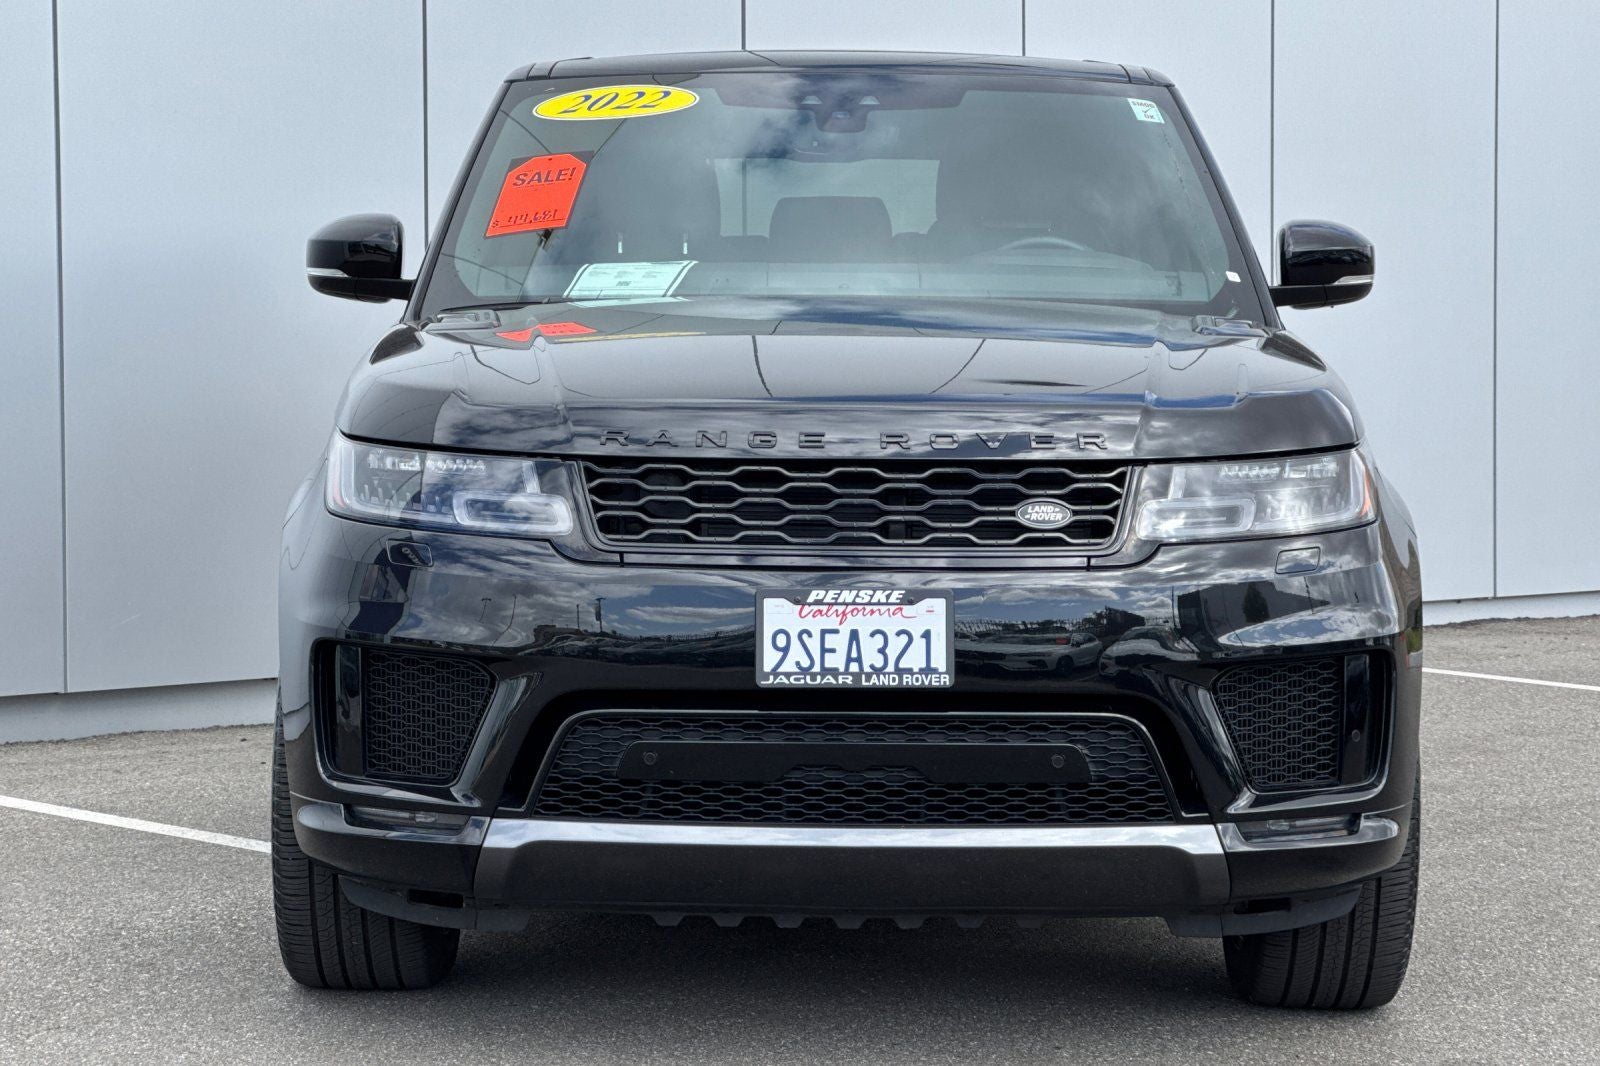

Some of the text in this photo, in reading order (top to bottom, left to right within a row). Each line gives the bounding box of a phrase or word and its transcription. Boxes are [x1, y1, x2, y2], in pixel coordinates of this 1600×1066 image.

[557, 90, 672, 114] 2022
[512, 167, 576, 186] SALE!
[599, 429, 1108, 450] RANGE ROVER
[1027, 505, 1055, 513] LAND
[1030, 512, 1063, 521] ROVER
[806, 589, 906, 603] PENSKE
[798, 604, 917, 626] California
[771, 628, 940, 673] 9SEA321
[761, 674, 950, 686] JAGUAR LAND ROVER
